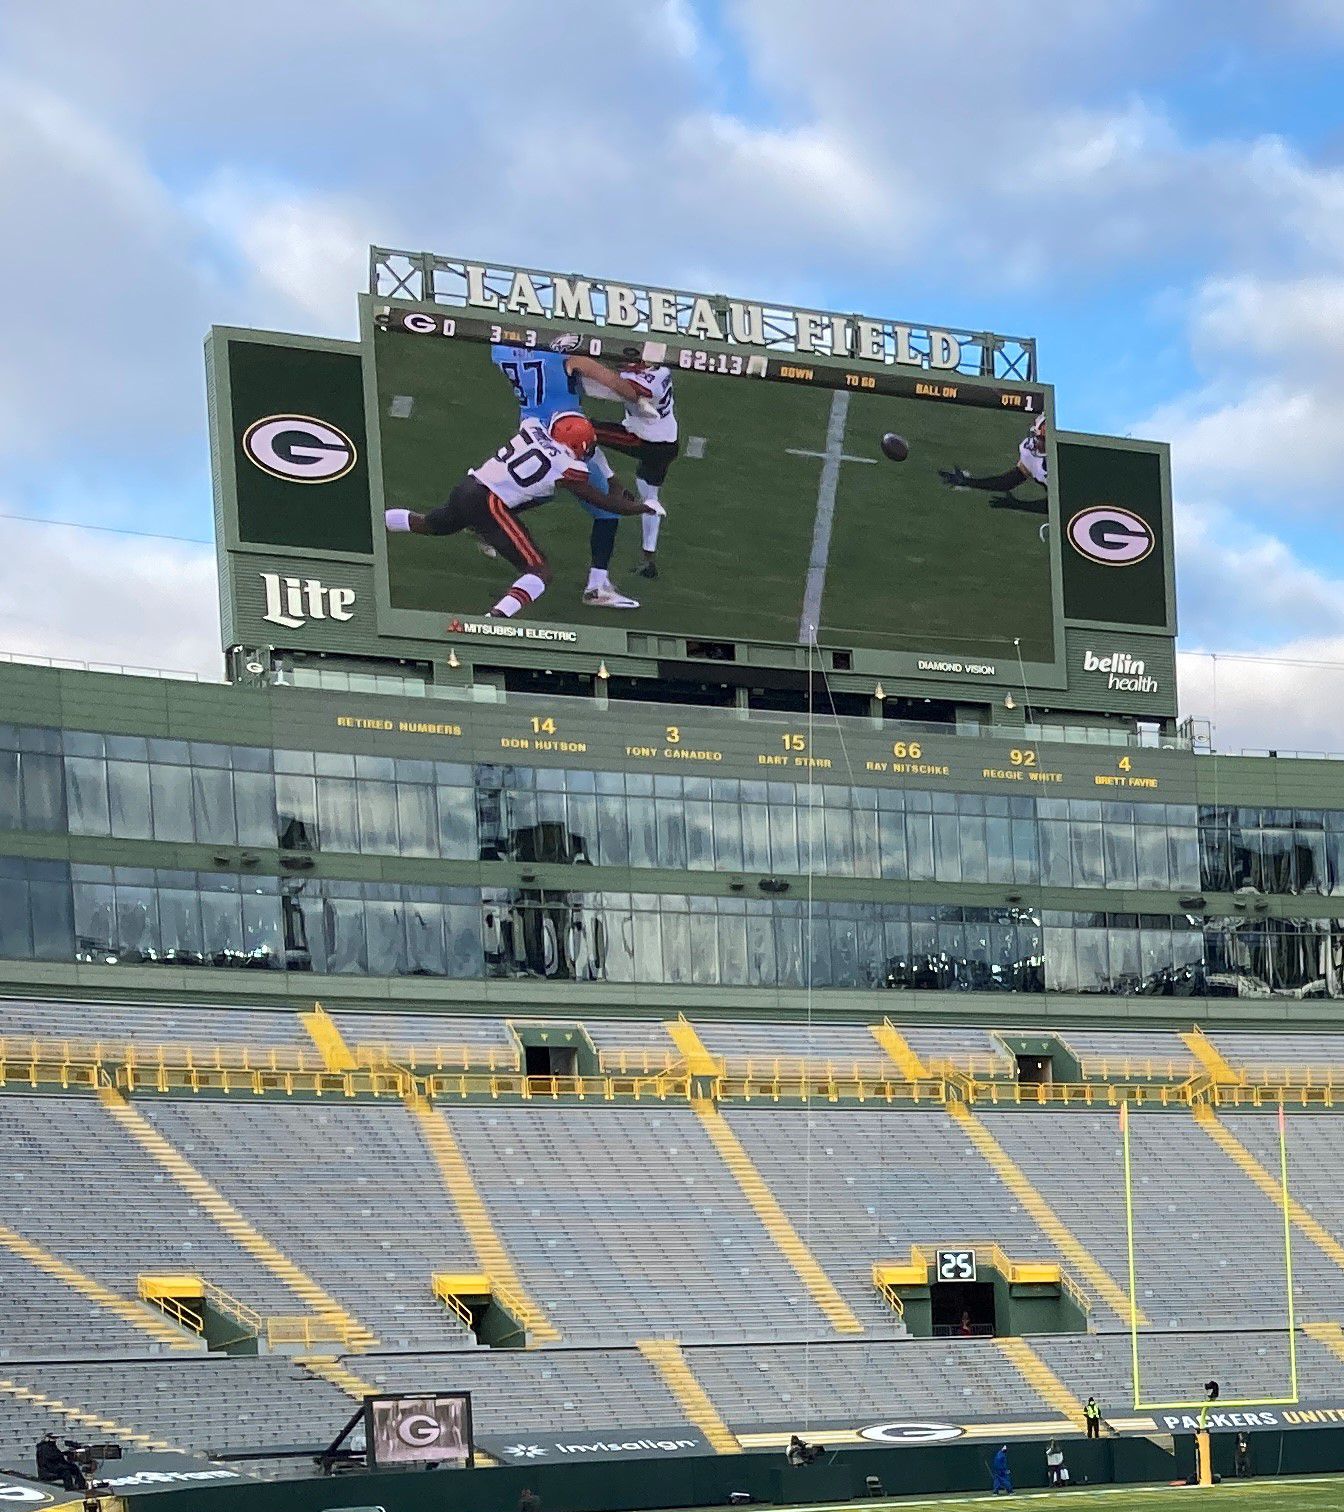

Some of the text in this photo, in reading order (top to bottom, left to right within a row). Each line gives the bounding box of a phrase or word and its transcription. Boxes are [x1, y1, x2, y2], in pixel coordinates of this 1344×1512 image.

[466, 264, 962, 370] LAMBEAU FIELD
[442, 319, 455, 337] 0
[490, 325, 501, 343] 3
[525, 329, 537, 347] 3
[589, 338, 601, 356] 0
[679, 350, 742, 375] 62:13
[780, 366, 813, 380] DOWN
[846, 374, 876, 388] TO GO
[915, 383, 958, 398] BALL ON
[1001, 394, 1034, 411] QTR 1
[250, 420, 350, 478] G
[1072, 509, 1151, 562] G
[259, 572, 356, 629] Lite
[463, 623, 577, 642] MITSUBISHI ELECTRIC
[918, 660, 995, 675] DIAMOND VISION
[1083, 651, 1145, 675] bellin
[1108, 673, 1158, 692] health
[337, 716, 462, 736] RETIRED NUMBERS
[530, 716, 557, 735] 14
[665, 726, 680, 743] 3
[501, 738, 587, 752] DON HUTSON
[781, 734, 805, 750] 15
[893, 741, 922, 759] 66
[625, 746, 722, 761] TONY CANADEO
[758, 755, 832, 769] BART STARR
[1009, 749, 1036, 767] 92
[866, 761, 949, 776] RAY NITSCHKE
[1118, 756, 1132, 773] 4
[983, 769, 1063, 783] REGGIE WHITE
[1095, 775, 1158, 788] BRETT FAVRE
[941, 1253, 972, 1278] 25
[1163, 1411, 1279, 1430] PACKERS
[399, 1414, 441, 1447] G
[859, 1423, 963, 1442] G
[555, 1438, 694, 1454] invisalign
